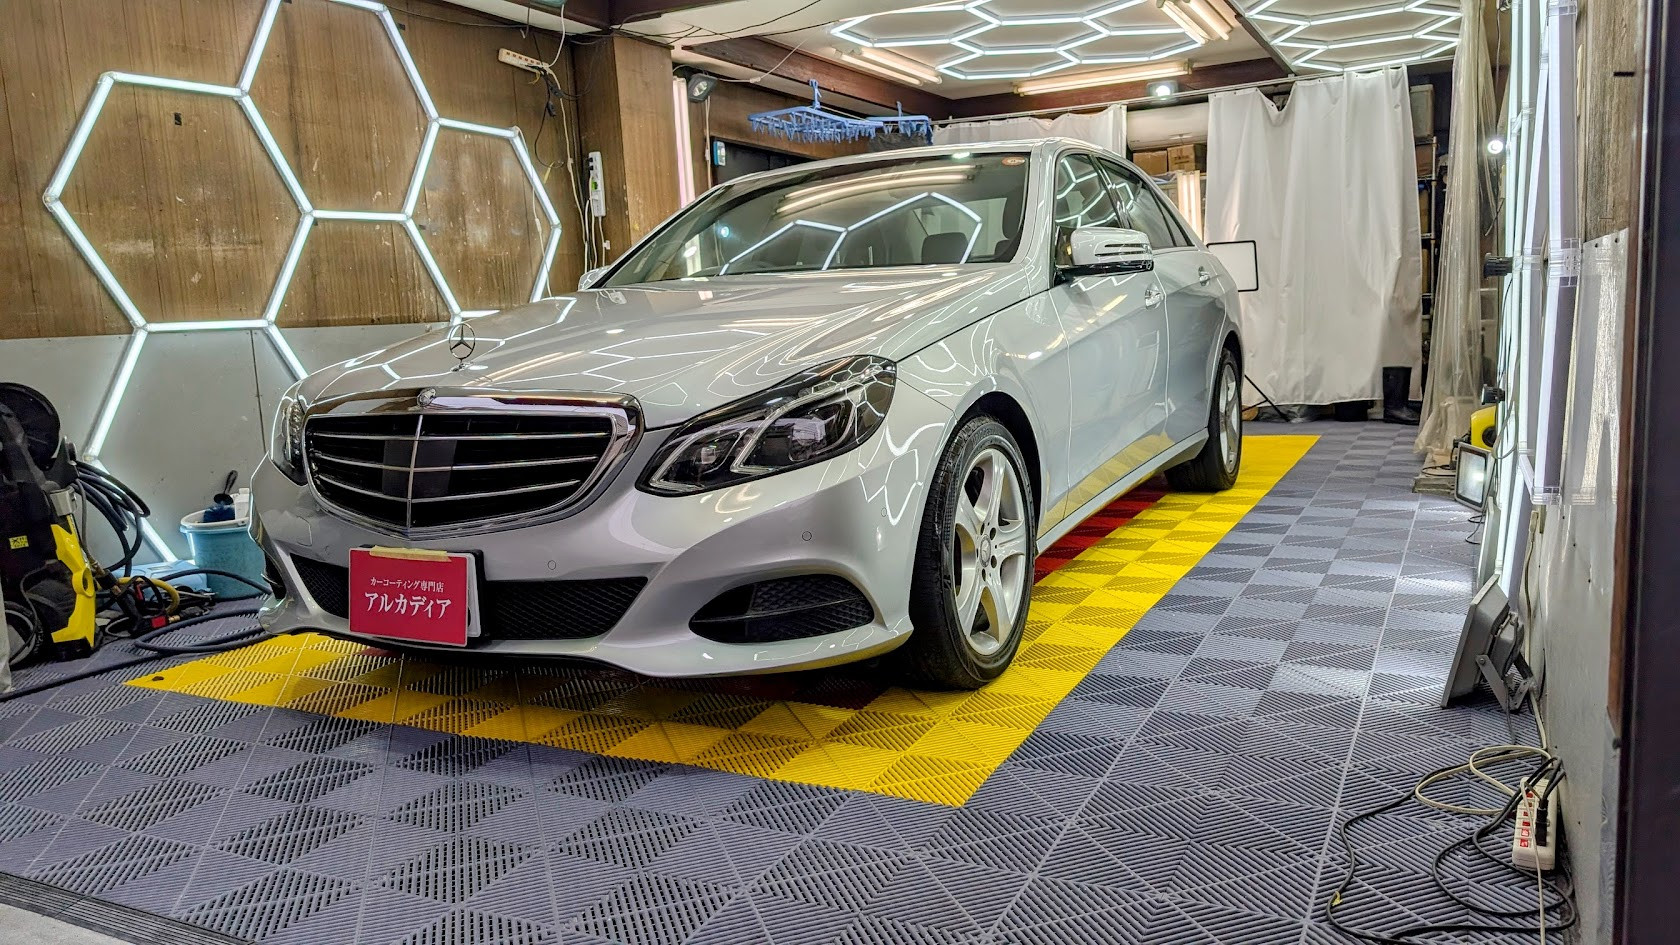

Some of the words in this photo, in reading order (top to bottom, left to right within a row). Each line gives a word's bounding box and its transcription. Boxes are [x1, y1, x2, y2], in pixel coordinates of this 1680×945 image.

[370, 576, 444, 593] カーコーティング専門店
[364, 591, 452, 619] アルカディア
